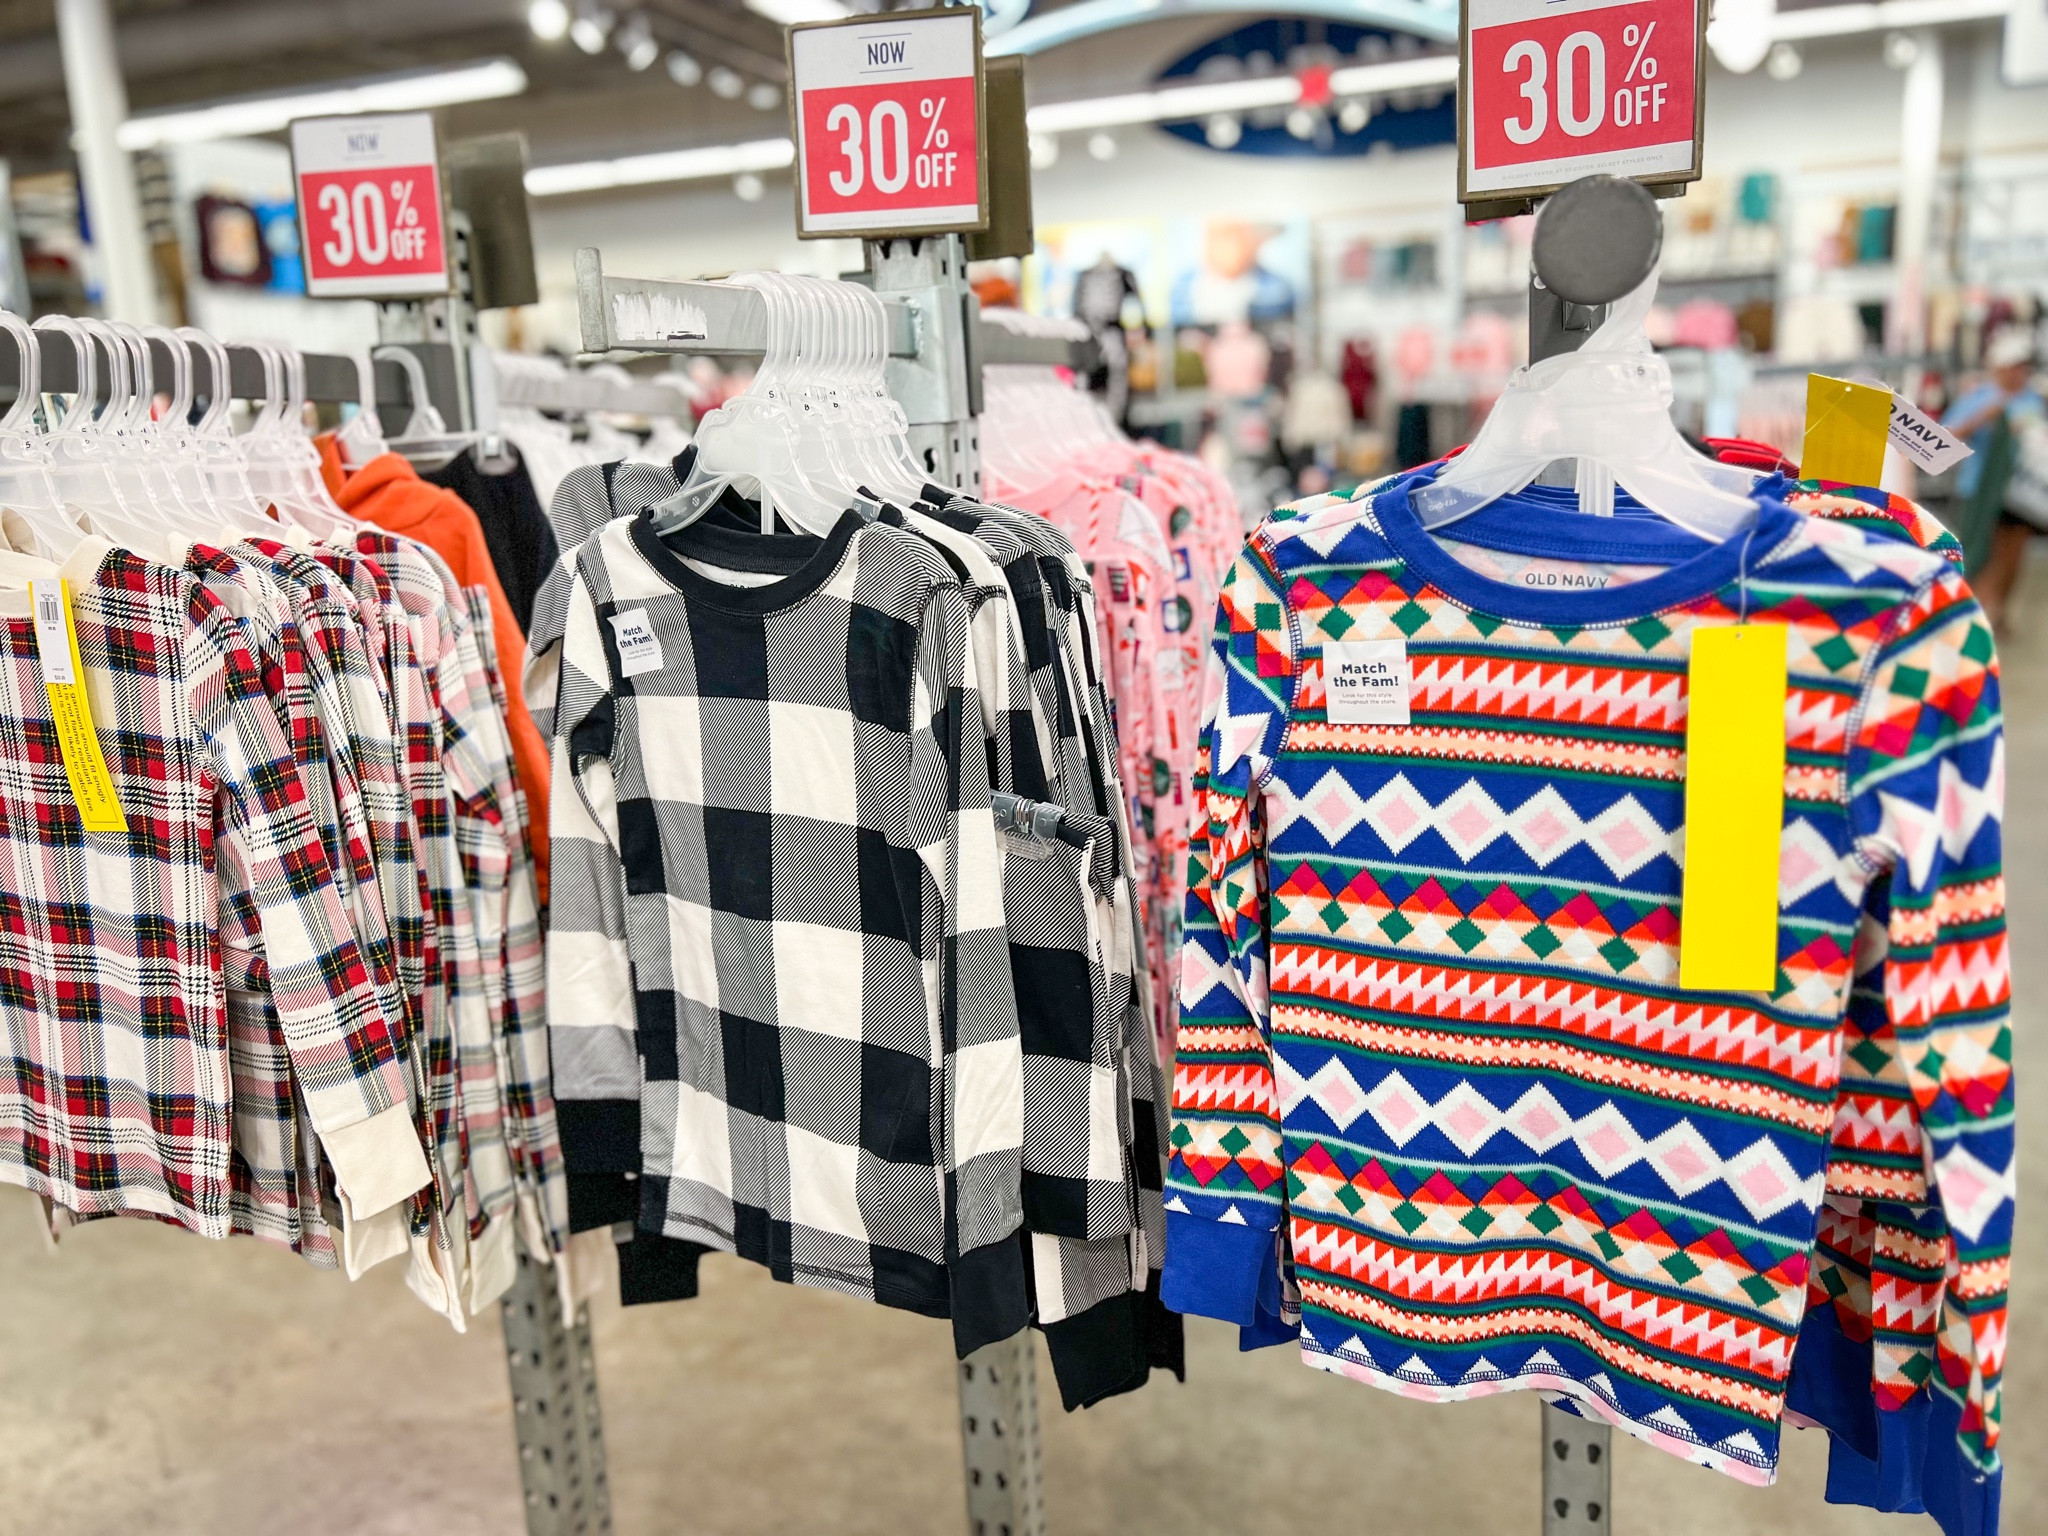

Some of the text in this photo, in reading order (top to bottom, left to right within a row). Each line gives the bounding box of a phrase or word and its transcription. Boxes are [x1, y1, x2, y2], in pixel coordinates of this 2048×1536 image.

[868, 41, 905, 65] NOW
[1614, 83, 1667, 127] OFF
[915, 152, 957, 188] OFF
[391, 222, 427, 261] OFF
[1896, 413, 1951, 451] NAVY
[1525, 573, 1609, 589] OLD NAVY
[620, 634, 653, 648] the Fam!
[623, 625, 643, 637] Match
[1342, 662, 1386, 674] Match
[1333, 676, 1399, 687] the Fam!
[62, 710, 71, 733] more
[65, 693, 69, 701] is
[71, 720, 80, 745] flame
[70, 692, 85, 731] garment
[81, 733, 93, 762] should
[68, 736, 76, 758] likely
[74, 761, 79, 770] to
[76, 772, 88, 795] catch
[85, 797, 94, 811] fire
